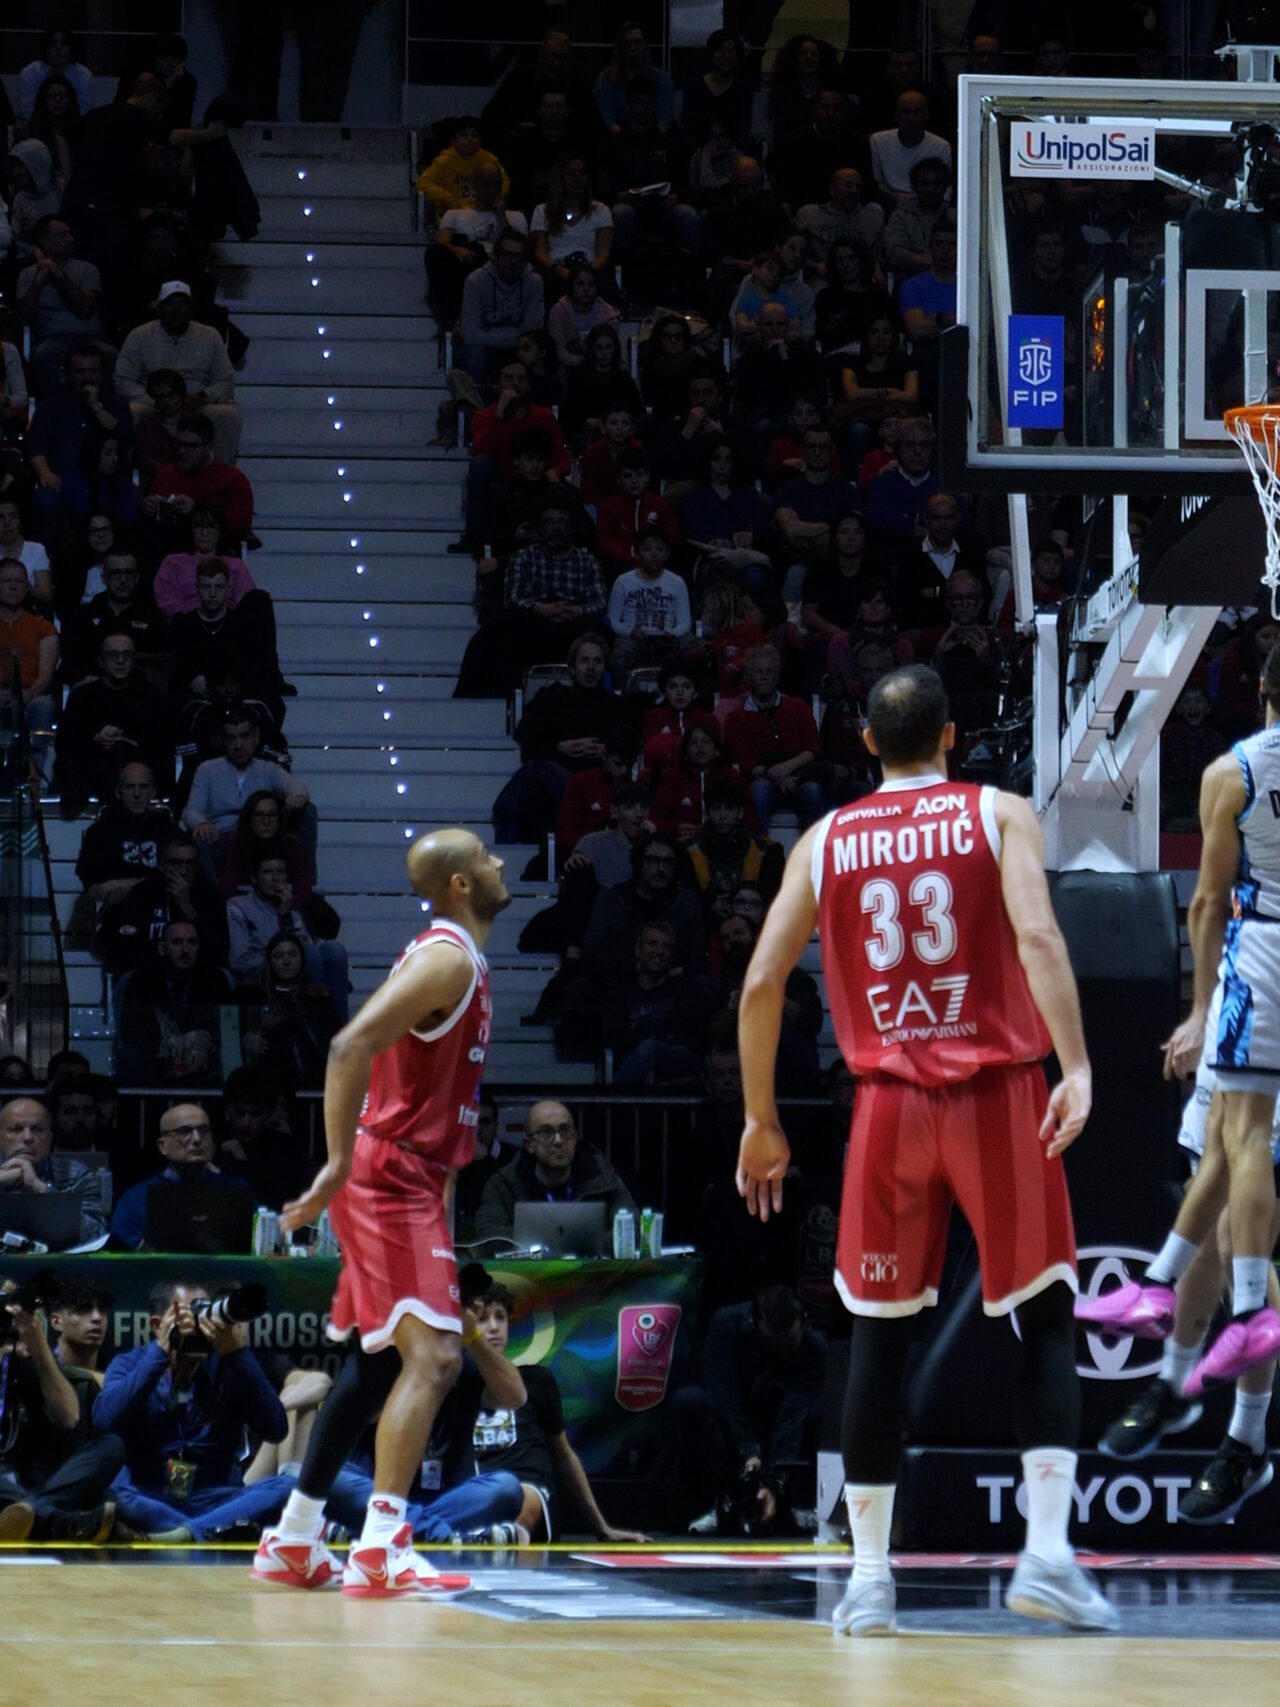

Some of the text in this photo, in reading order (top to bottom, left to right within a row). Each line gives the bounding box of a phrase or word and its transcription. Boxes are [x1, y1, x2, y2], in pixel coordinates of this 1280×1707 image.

[1026, 130, 1149, 169] UnipolSai
[1076, 164, 1149, 173] ASSICURAZIONI
[1013, 390, 1058, 407] FIP
[836, 794, 967, 826] DRIVALIA AON
[832, 810, 975, 876] MIROTIĆ
[859, 870, 959, 973] 33
[865, 973, 971, 1033] EA7
[975, 1475, 1235, 1525] TYOT
